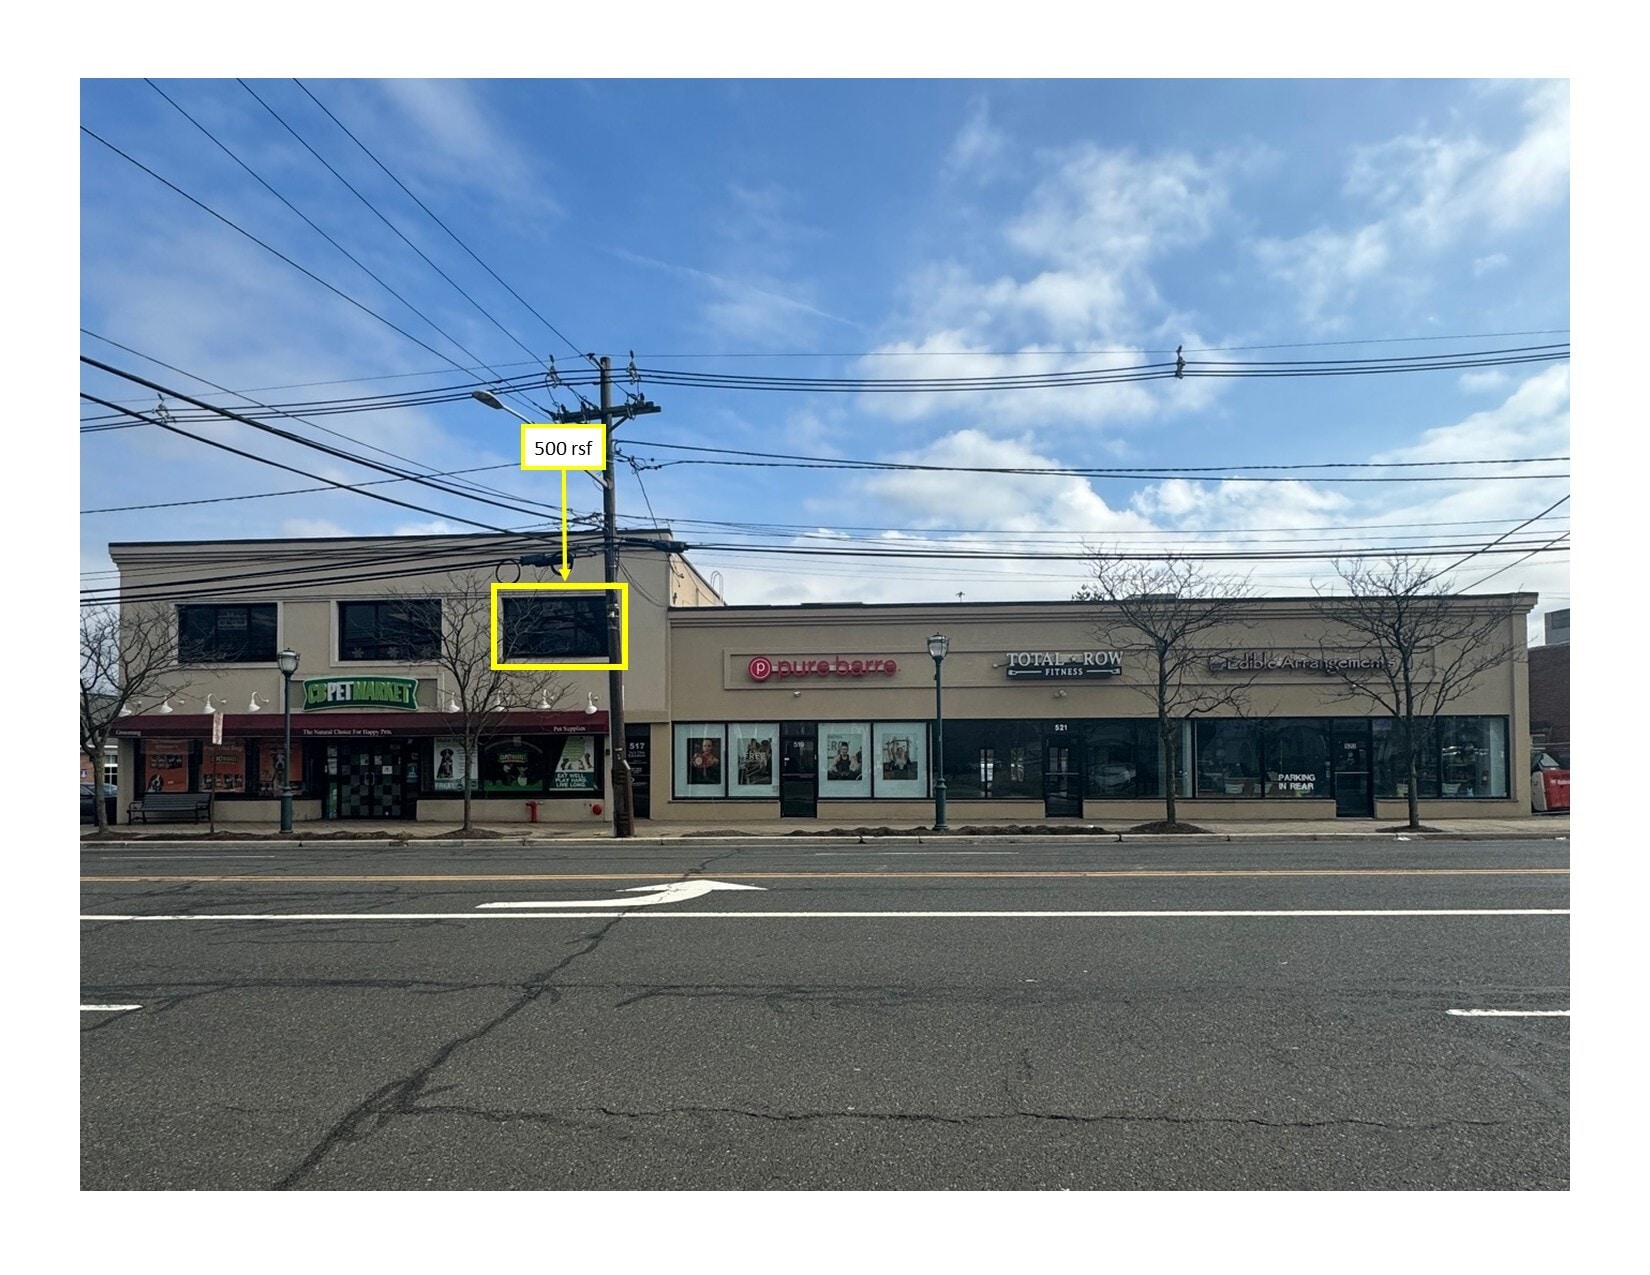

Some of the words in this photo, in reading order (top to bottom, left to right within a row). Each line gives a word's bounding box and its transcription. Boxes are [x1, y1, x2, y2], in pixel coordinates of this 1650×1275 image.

[1006, 652, 1065, 667] TOTAL
[1083, 651, 1124, 666] ROW
[1227, 652, 1278, 670] Edible
[778, 660, 830, 680] pure
[835, 656, 897, 677] barre
[1045, 668, 1084, 676] FITNESS
[563, 725, 586, 733] Supplies
[1054, 724, 1068, 732] 521
[362, 728, 380, 737] Happy
[629, 742, 646, 750] 517
[1278, 773, 1316, 782] PARKING
[1278, 782, 1287, 790] IN
[1290, 782, 1314, 790] REAR
